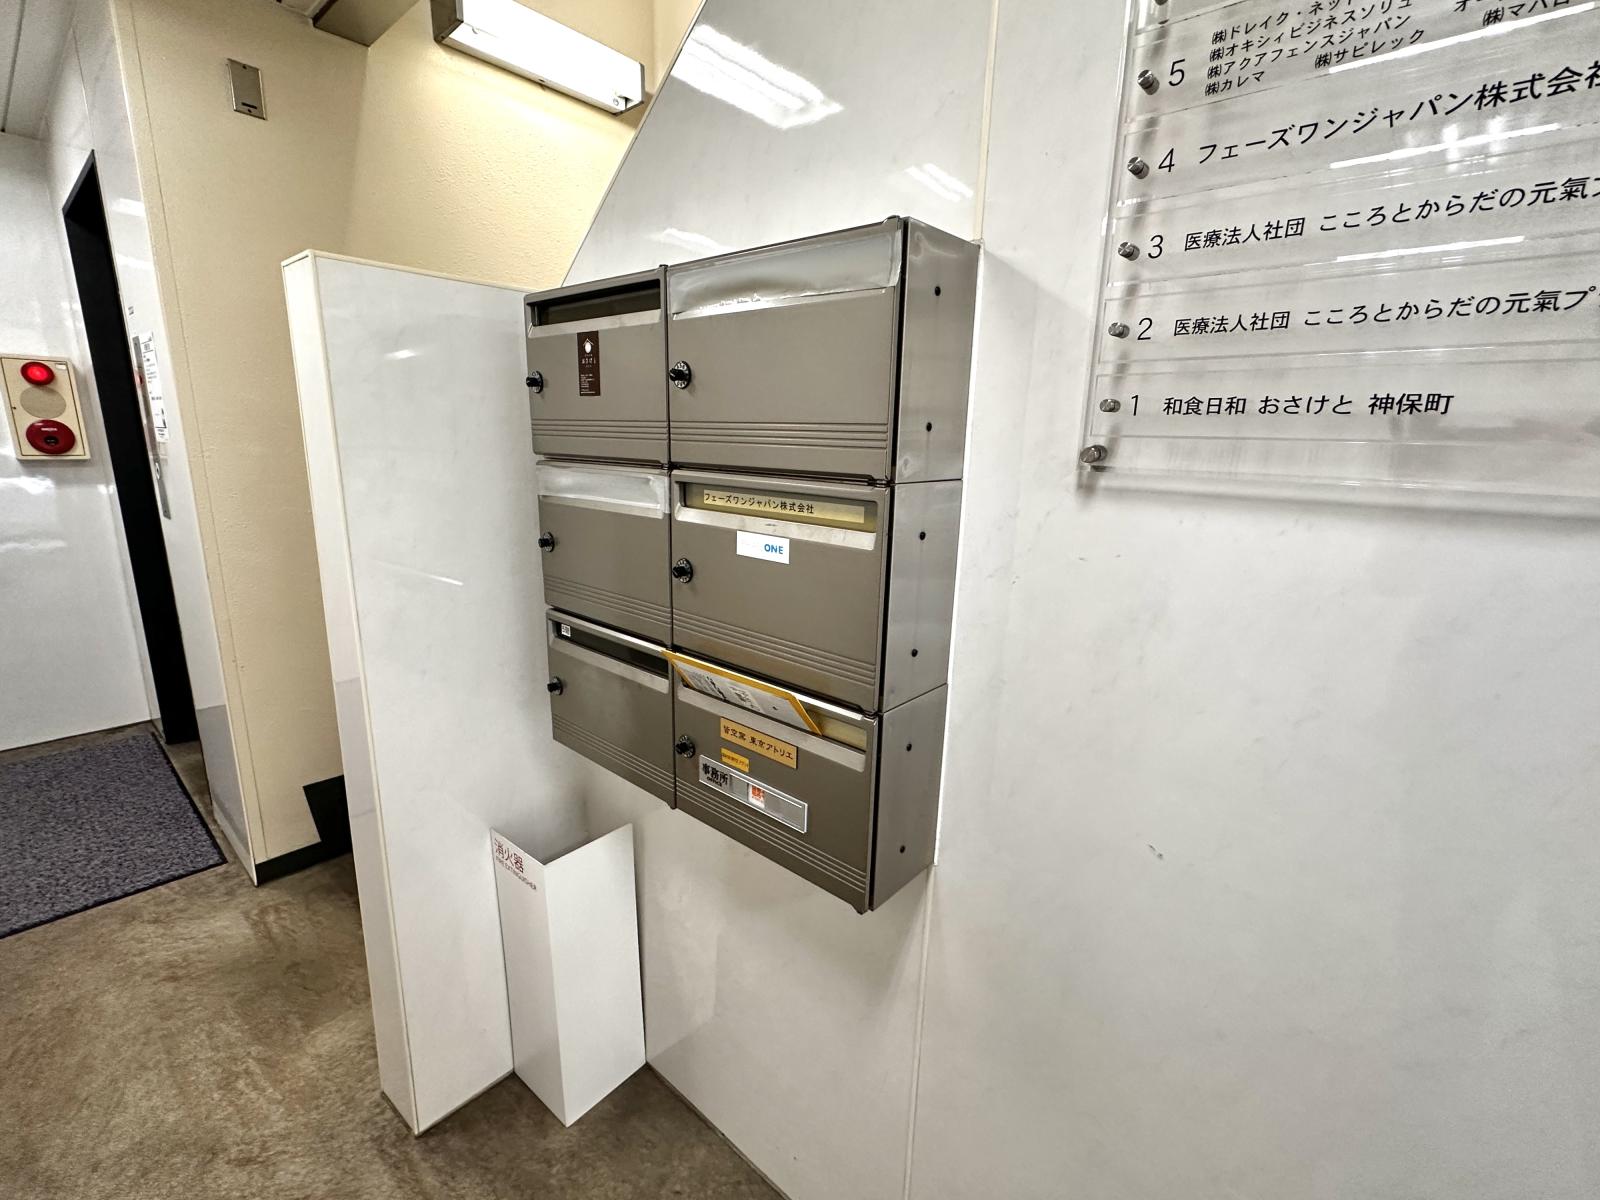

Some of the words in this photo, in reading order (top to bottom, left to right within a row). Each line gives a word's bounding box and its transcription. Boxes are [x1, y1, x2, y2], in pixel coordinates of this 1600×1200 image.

[1168, 58, 1185, 87] 5
[1158, 147, 1175, 173] 4
[1147, 234, 1164, 259] 3
[1184, 217, 1306, 251] 医療法人社団
[1320, 177, 1600, 231] こころとからだの元氣
[1137, 317, 1153, 341] 2
[1174, 311, 1291, 336] 医療法人社団
[1304, 285, 1600, 325] こころとからだの元氣プ
[1131, 394, 1139, 417] 1
[1162, 396, 1247, 416] 和食日和
[1257, 395, 1353, 415] おさけと
[1367, 392, 1455, 416] 神保町
[704, 493, 815, 514] フェーズワンジャパン株式会社
[763, 543, 784, 555] ONE
[494, 838, 524, 873] 消火器
